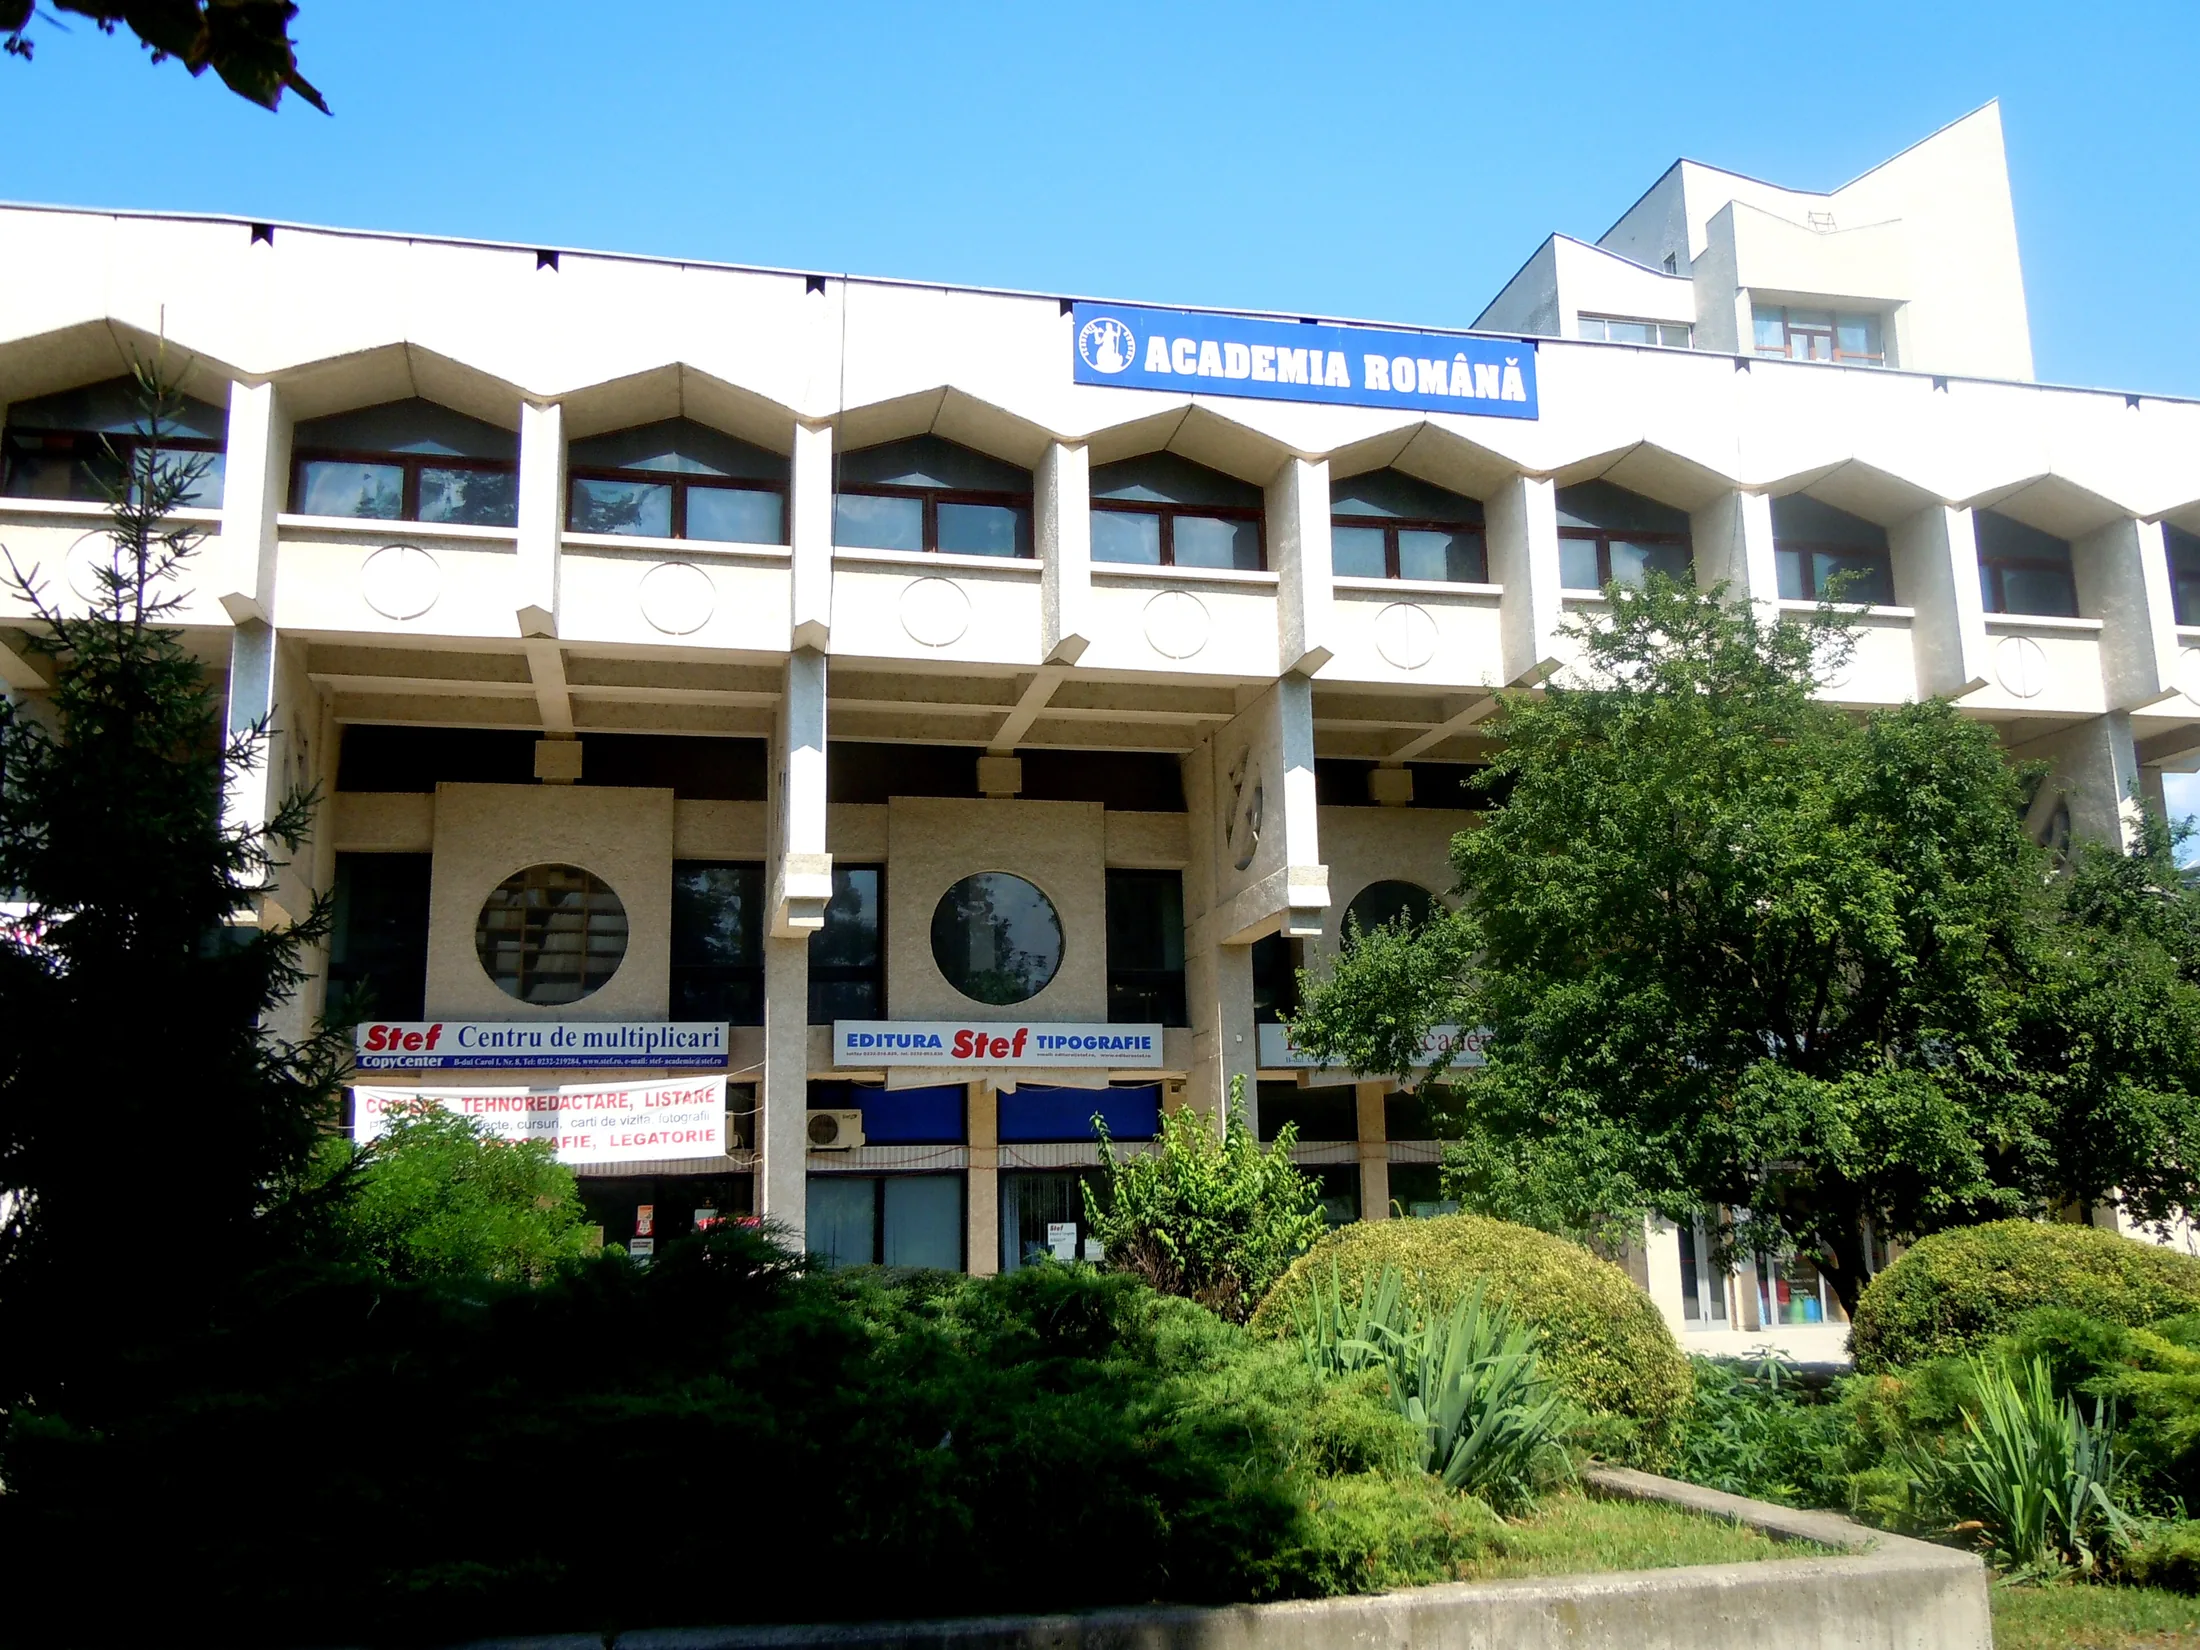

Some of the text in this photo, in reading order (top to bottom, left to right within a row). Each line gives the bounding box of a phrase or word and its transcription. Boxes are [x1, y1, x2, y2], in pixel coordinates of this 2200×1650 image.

[1144, 335, 1350, 388] ACADEMIA
[1364, 353, 1526, 402] ROMÂNĂ
[364, 1023, 720, 1054] Stef Centru de multiplicari
[847, 1027, 1151, 1059] EDITURA Stef TIPOGRAFIE
[362, 1056, 443, 1068] CopyCenter
[454, 1058, 473, 1066] B-dul
[475, 1058, 494, 1066] Carol
[523, 1058, 535, 1066] Tel:
[624, 1057, 648, 1066] e-mail:
[462, 1092, 634, 1113] TEHNOREDACTARE,
[645, 1088, 716, 1107] LISTARE
[517, 1117, 563, 1130] cursuri,
[571, 1116, 597, 1128] carti
[601, 1115, 616, 1127] de
[658, 1110, 710, 1125] fotografii
[610, 1129, 716, 1147] LEGATORIE
